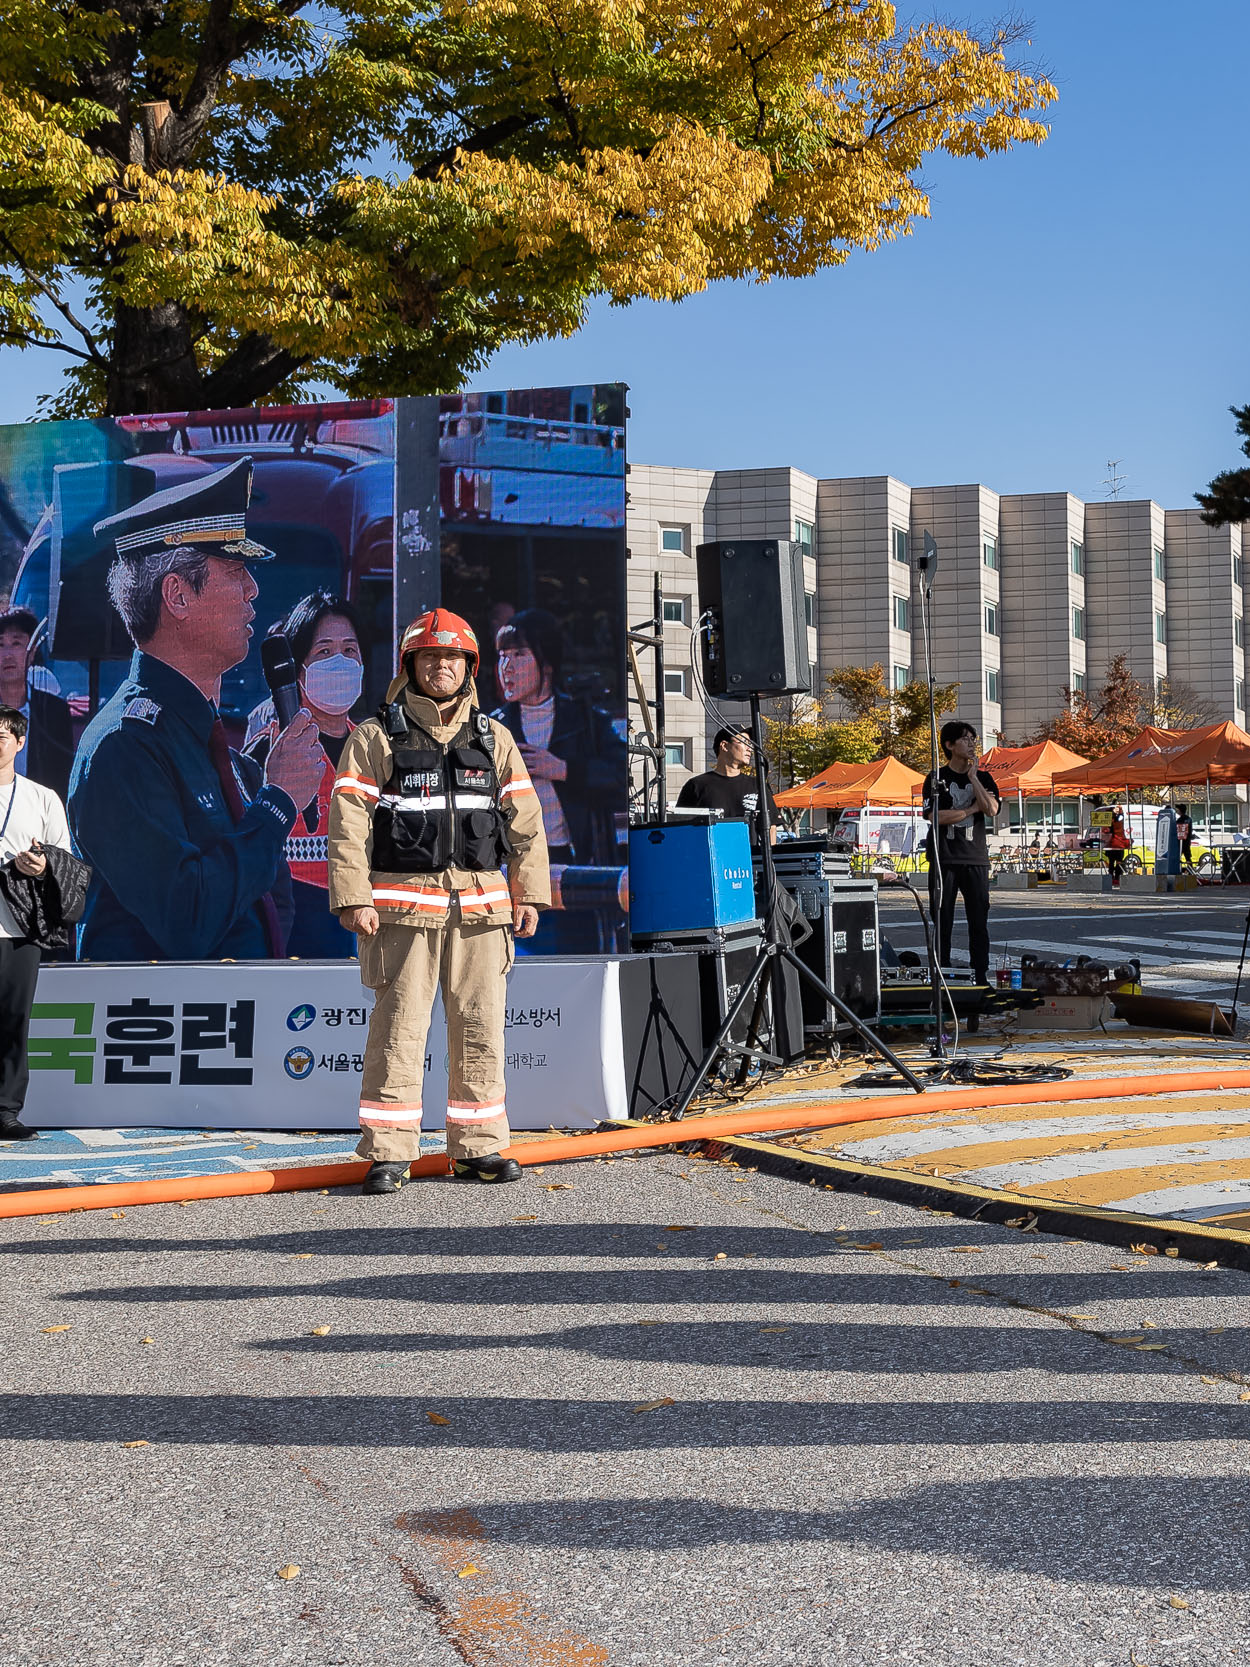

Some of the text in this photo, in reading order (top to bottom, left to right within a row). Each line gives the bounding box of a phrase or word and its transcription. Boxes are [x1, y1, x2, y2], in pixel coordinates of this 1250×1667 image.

[723, 867, 750, 880] Choice
[320, 1008, 374, 1027] 광진
[504, 1007, 561, 1028] 진소방서
[504, 1052, 548, 1070] 대학교
